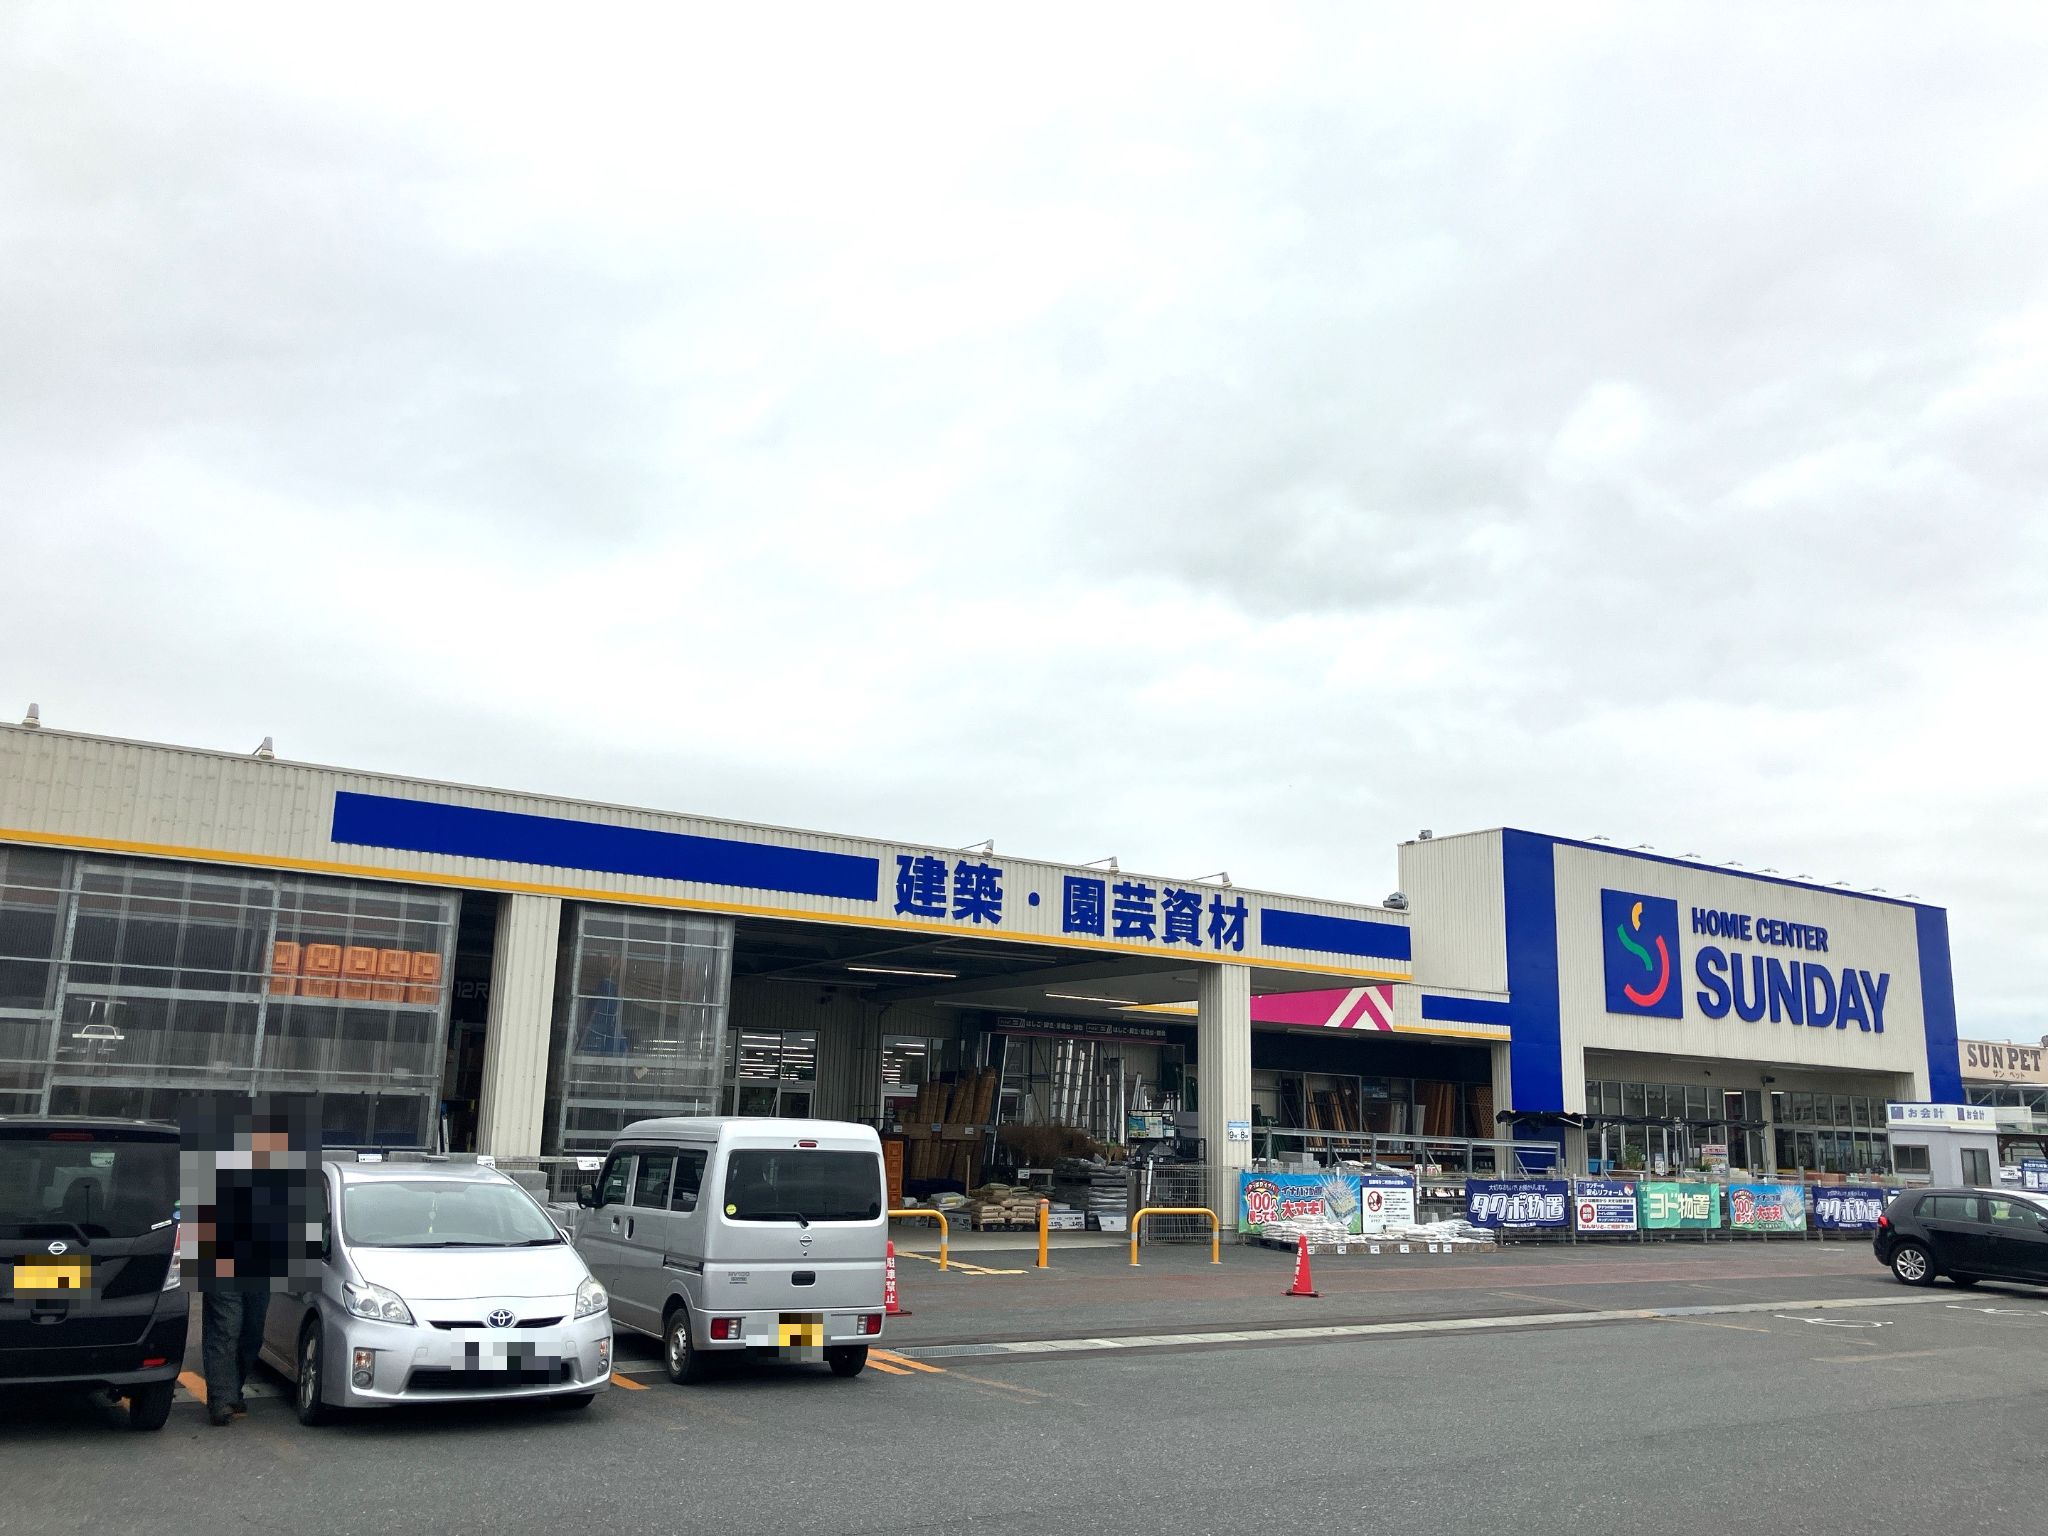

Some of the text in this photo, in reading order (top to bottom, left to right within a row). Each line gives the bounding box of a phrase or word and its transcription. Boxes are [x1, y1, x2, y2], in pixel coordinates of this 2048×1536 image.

[893, 854, 1249, 952] 建築・園芸資材
[1692, 907, 1828, 952] HOME CENTER
[1695, 946, 1890, 1033] SUNDAY
[1967, 1043, 2041, 1072] SUN PET
[1908, 1107, 1944, 1119] お会計
[1966, 1109, 1985, 1121] お会計
[1248, 1192, 1278, 1211] 100人
[1470, 1192, 1565, 1222] タクボ物置
[1649, 1192, 1711, 1219] ヨド物置
[1816, 1197, 1883, 1222] タクボ物置
